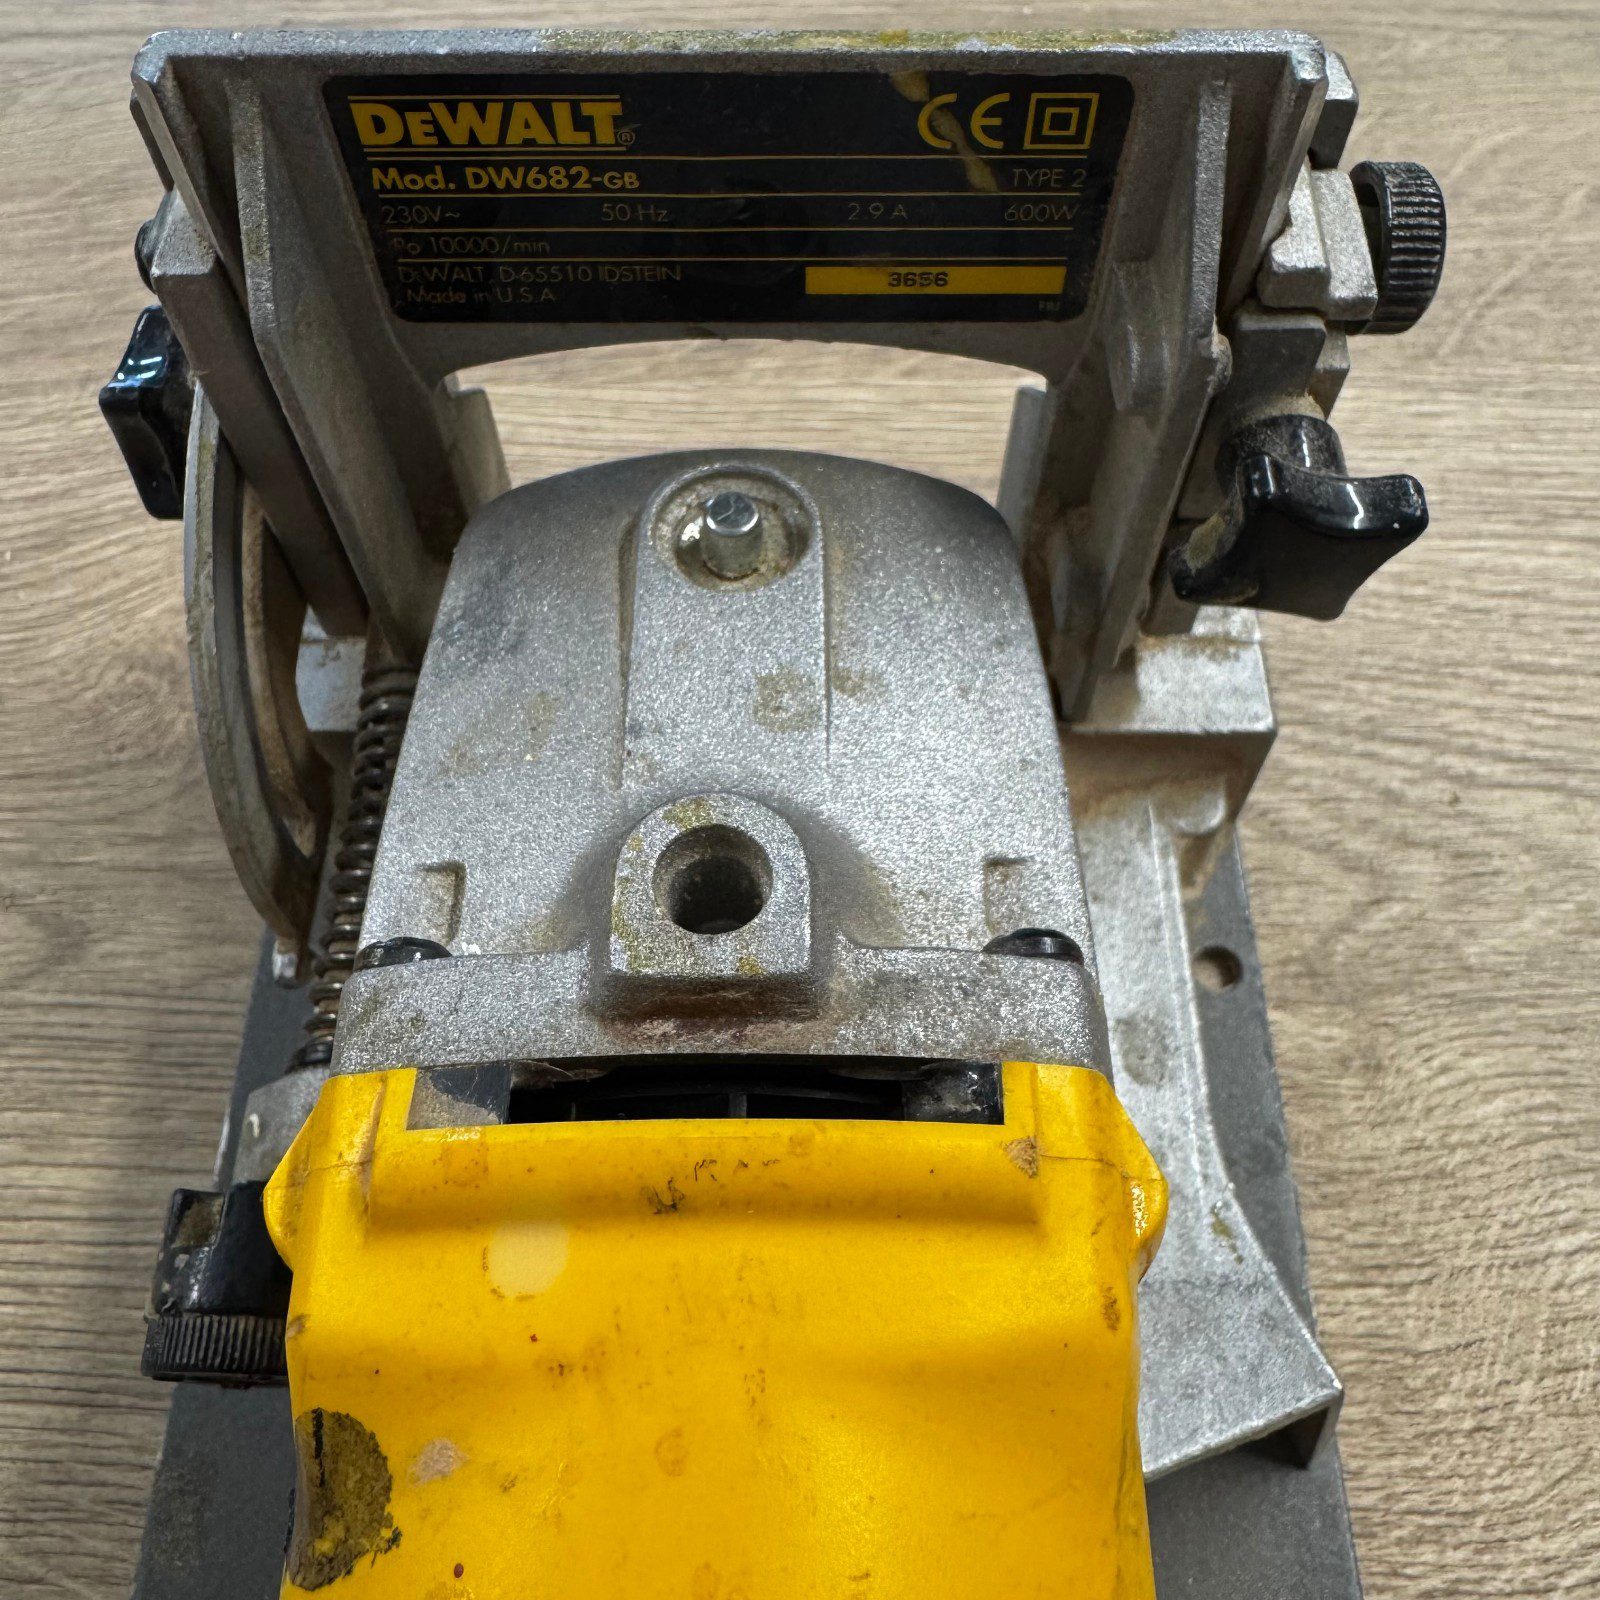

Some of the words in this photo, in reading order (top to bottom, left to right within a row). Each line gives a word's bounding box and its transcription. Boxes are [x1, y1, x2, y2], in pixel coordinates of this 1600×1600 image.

[371, 165, 456, 190] Mod.
[465, 165, 640, 190] DW682-GB
[1012, 168, 1064, 188] TYPE
[1071, 168, 1087, 188] 2
[601, 203, 631, 222] 50
[638, 204, 669, 222] Hz
[1004, 203, 1079, 222] 600W
